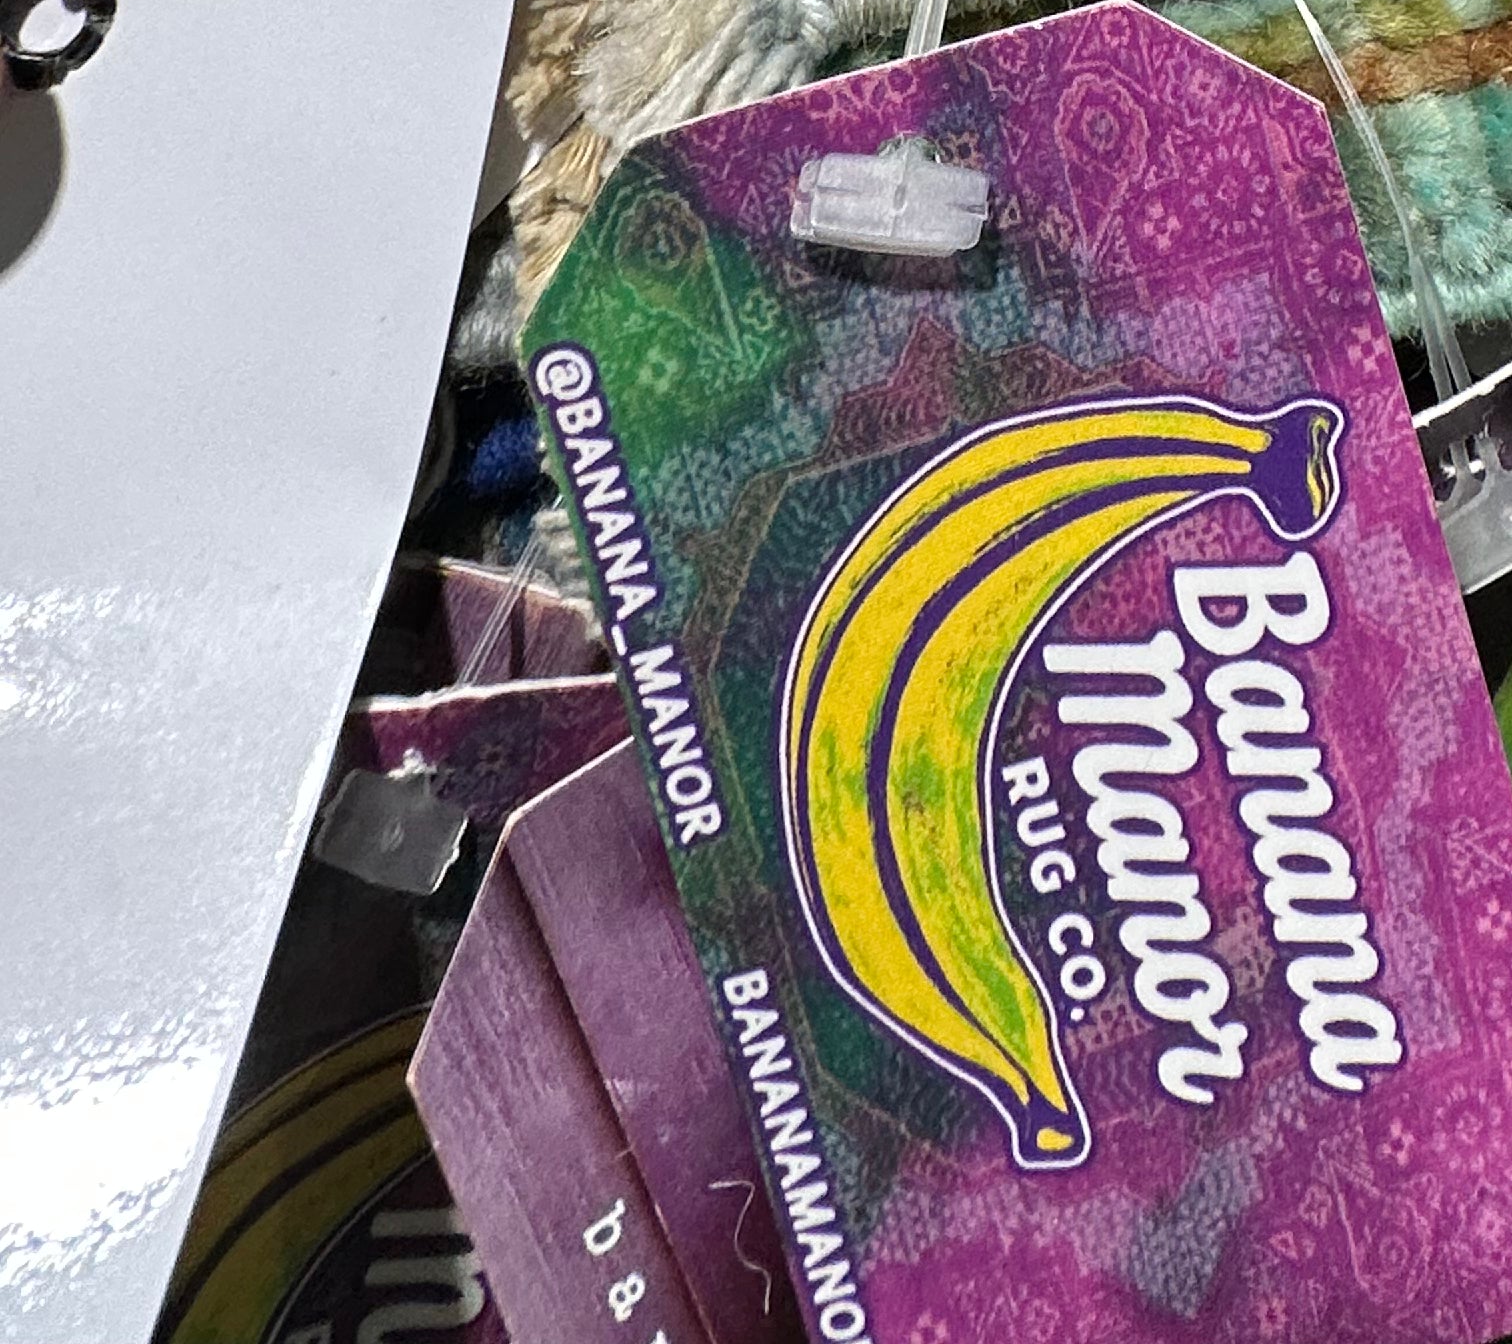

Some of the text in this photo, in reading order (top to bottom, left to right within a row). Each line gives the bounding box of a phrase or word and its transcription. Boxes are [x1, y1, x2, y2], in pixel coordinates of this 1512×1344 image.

[533, 347, 721, 844] @BANANA_MANOR
[1173, 550, 1405, 1092] Banana
[1001, 755, 1106, 1022] RUG CO.
[1042, 630, 1250, 1104] Manor
[722, 969, 871, 1344] BANANAMANO
